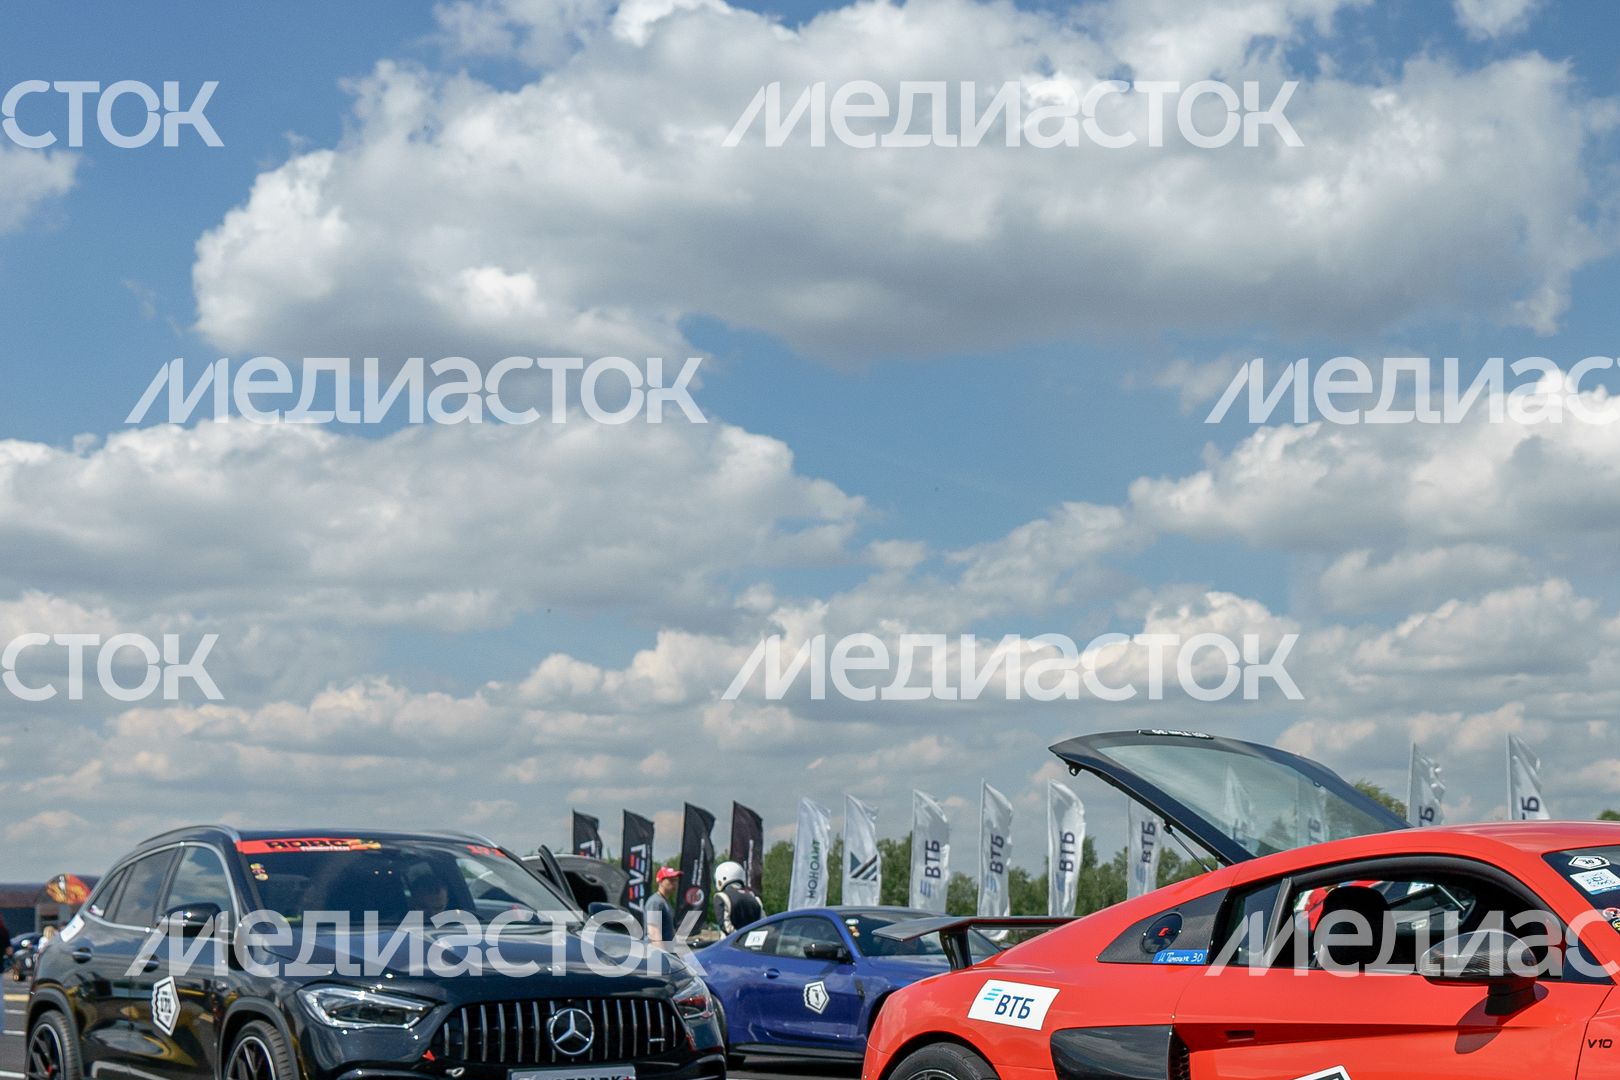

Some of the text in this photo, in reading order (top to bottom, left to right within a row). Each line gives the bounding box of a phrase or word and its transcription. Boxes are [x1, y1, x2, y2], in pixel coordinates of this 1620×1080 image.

[925, 840, 941, 879] ВТБ
[989, 833, 1004, 875] ВТБ
[1059, 831, 1075, 872] ВТБ
[1140, 821, 1156, 863] ВТБ
[1191, 952, 1203, 962] 30
[994, 994, 1035, 1019] ВТБ
[1588, 1039, 1613, 1048] V10
